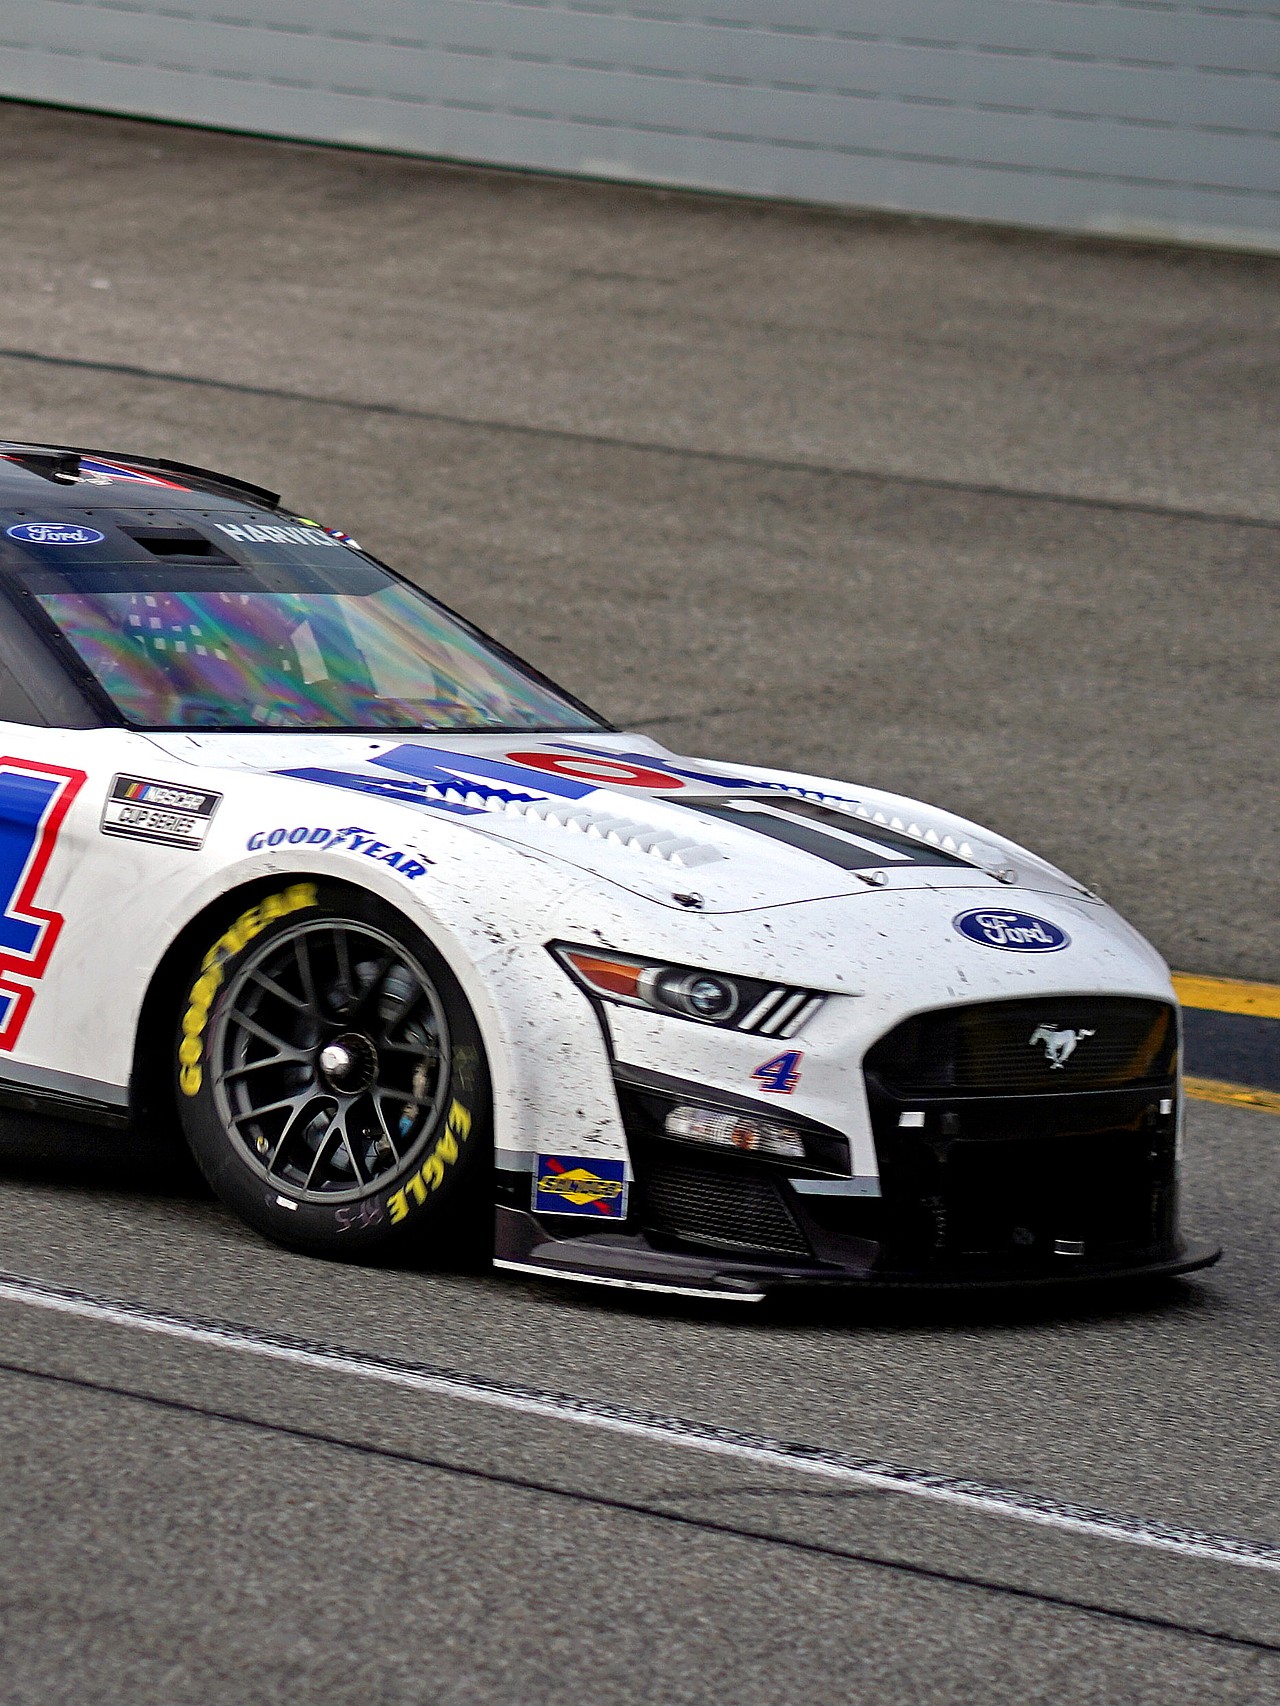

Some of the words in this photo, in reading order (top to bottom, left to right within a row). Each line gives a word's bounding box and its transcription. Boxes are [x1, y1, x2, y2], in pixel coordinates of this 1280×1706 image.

[26, 525, 90, 542] Ford
[143, 786, 207, 812] NASCAR
[119, 807, 147, 824] CUP
[147, 813, 197, 833] SERIES
[246, 826, 426, 880] GOODYEAR
[975, 913, 1054, 945] Ford
[749, 1049, 805, 1095] 4
[387, 1097, 472, 1226] EAGLE
